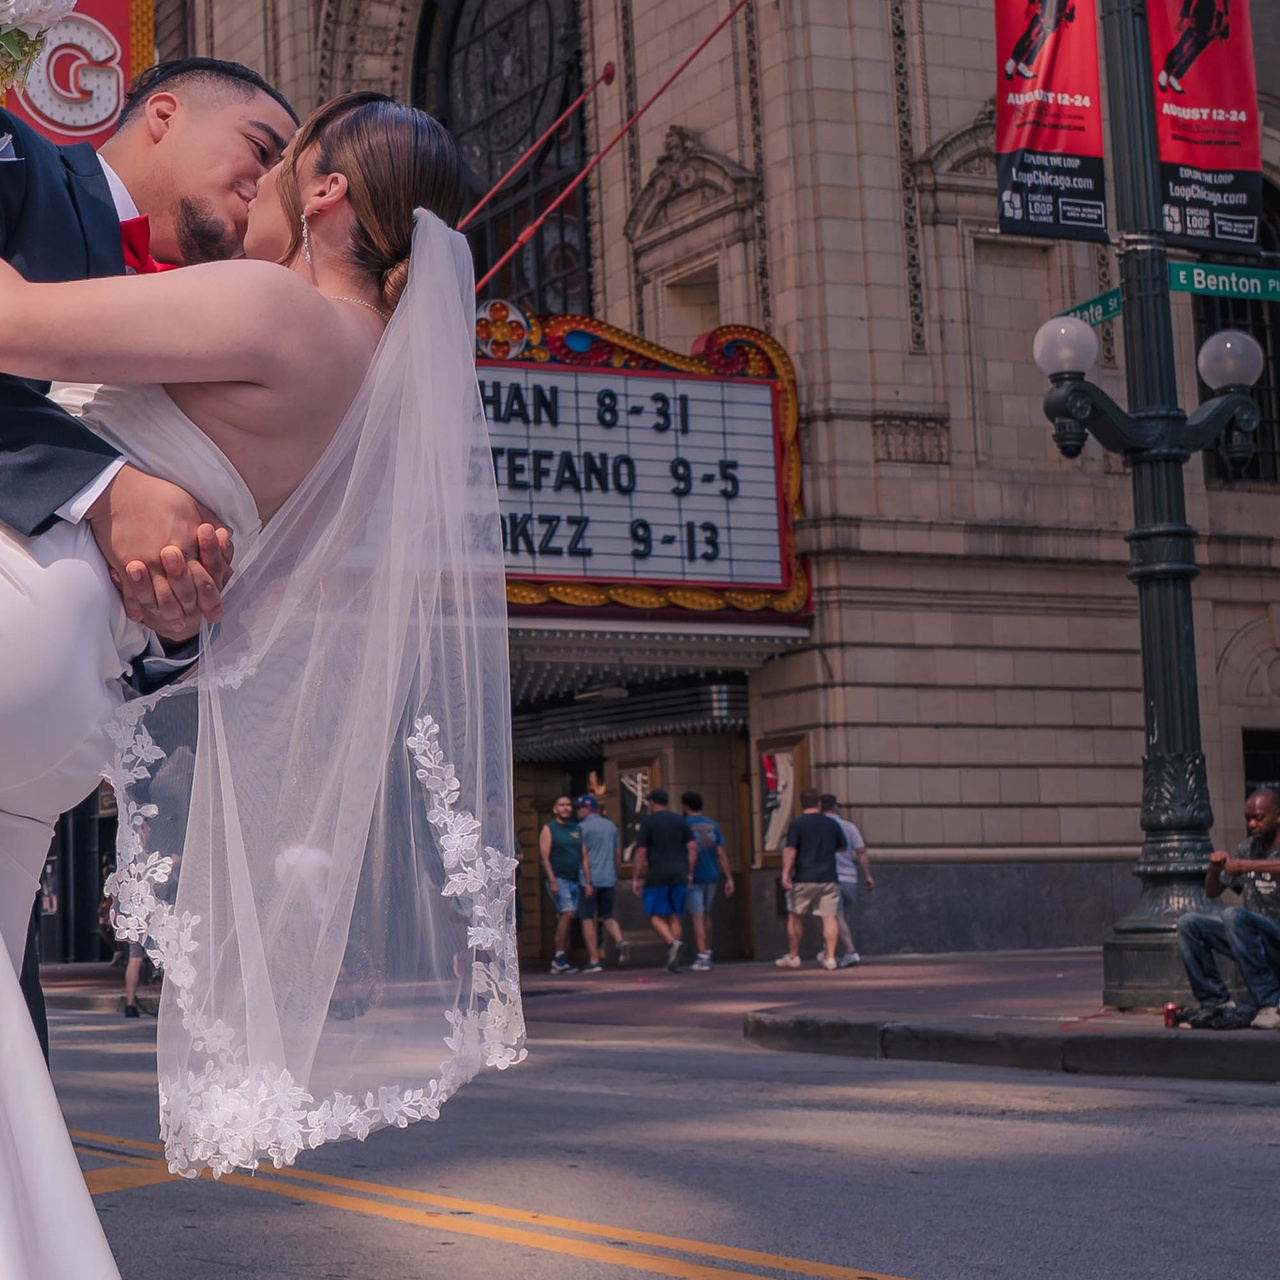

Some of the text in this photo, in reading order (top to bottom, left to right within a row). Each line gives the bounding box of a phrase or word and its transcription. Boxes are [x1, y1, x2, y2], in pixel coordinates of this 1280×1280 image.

[1007, 89, 1091, 108] AUGUST 12-24
[1162, 102, 1247, 122] AUGUST 12-24
[1049, 156, 1062, 167] THE
[1063, 157, 1081, 169] LOOP
[1012, 167, 1094, 191] LoopChicago.com
[1214, 173, 1234, 184] LOOP
[1169, 181, 1248, 206] LoopChicago.com
[1028, 201, 1053, 215] LOOP
[1186, 215, 1211, 229] LOOP
[1179, 270, 1188, 284] E
[1193, 268, 1262, 294] Benton
[1108, 297, 1118, 311] St
[596, 388, 690, 435] 8-31
[671, 457, 740, 499] 9-5
[500, 512, 721, 562] KZZ 9-13
